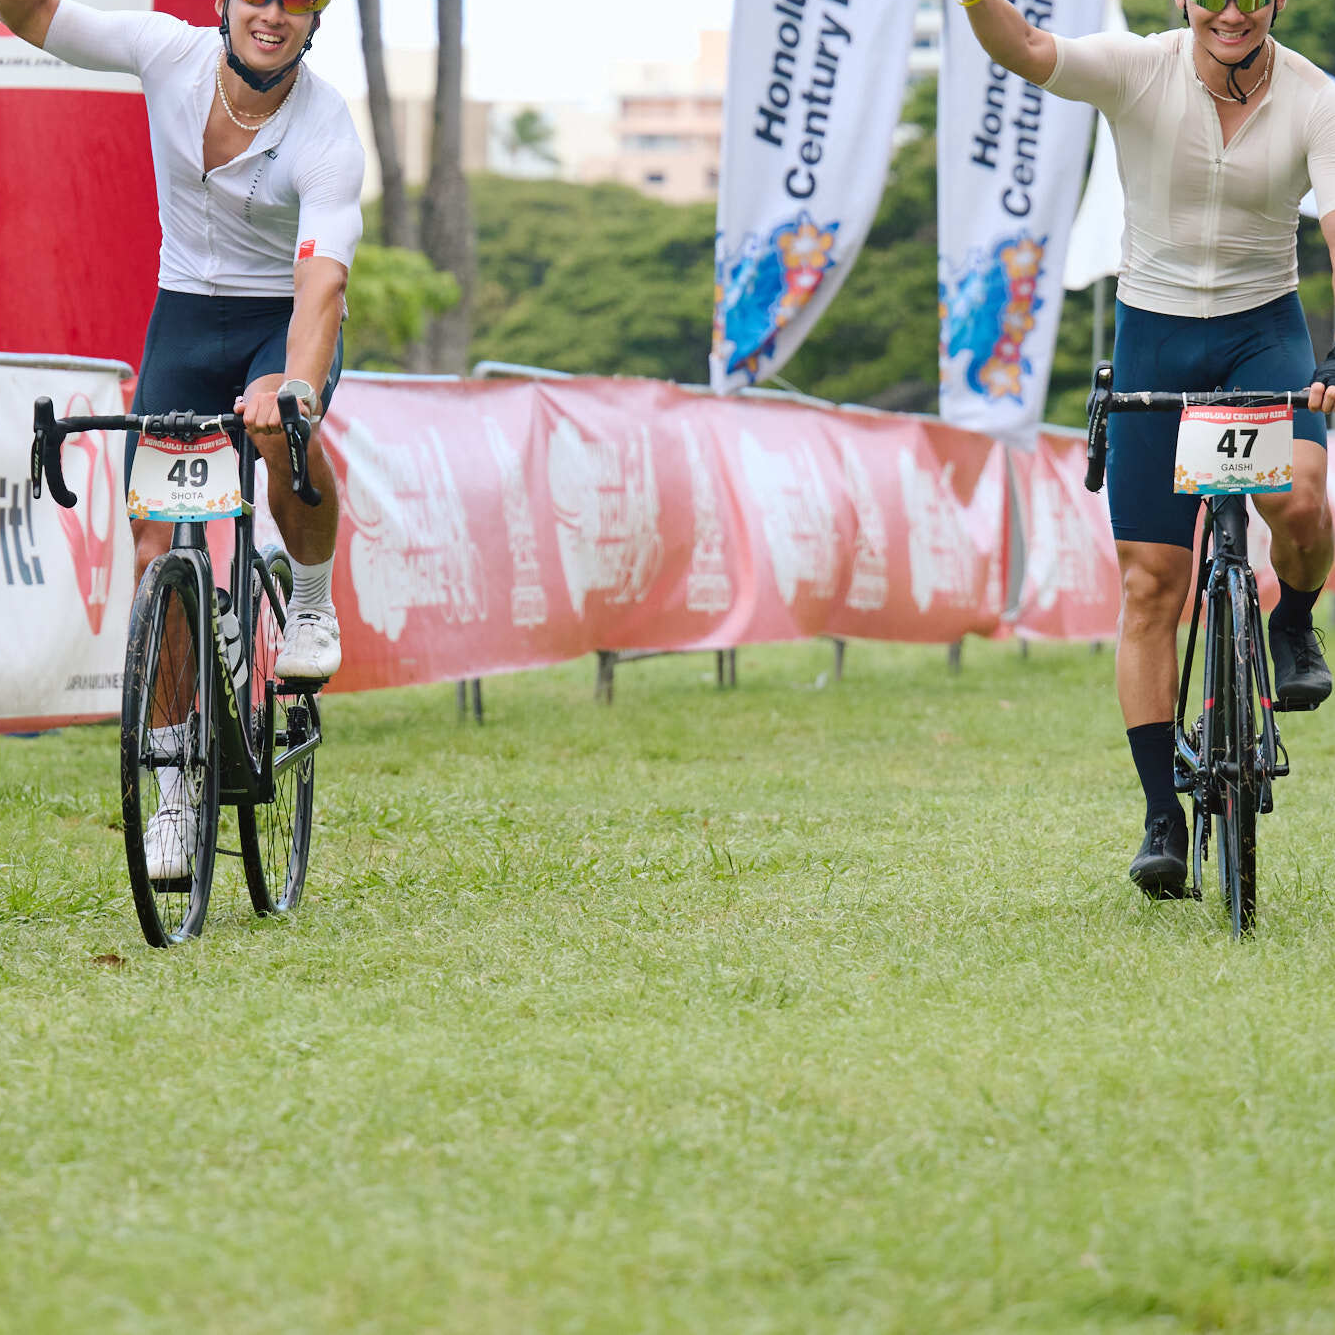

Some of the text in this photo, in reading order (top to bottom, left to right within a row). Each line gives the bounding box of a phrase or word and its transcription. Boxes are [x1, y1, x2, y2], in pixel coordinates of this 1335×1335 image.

[784, 12, 853, 200] Century
[1187, 410, 1288, 421] HONOLULU CENTURY RIDE
[144, 438, 183, 452] HONOLULU
[183, 440, 216, 452] CENTURY
[1216, 428, 1259, 459] 47
[167, 458, 209, 488] 49
[1220, 463, 1253, 472] GAISHI
[170, 490, 205, 501] SHOTA
